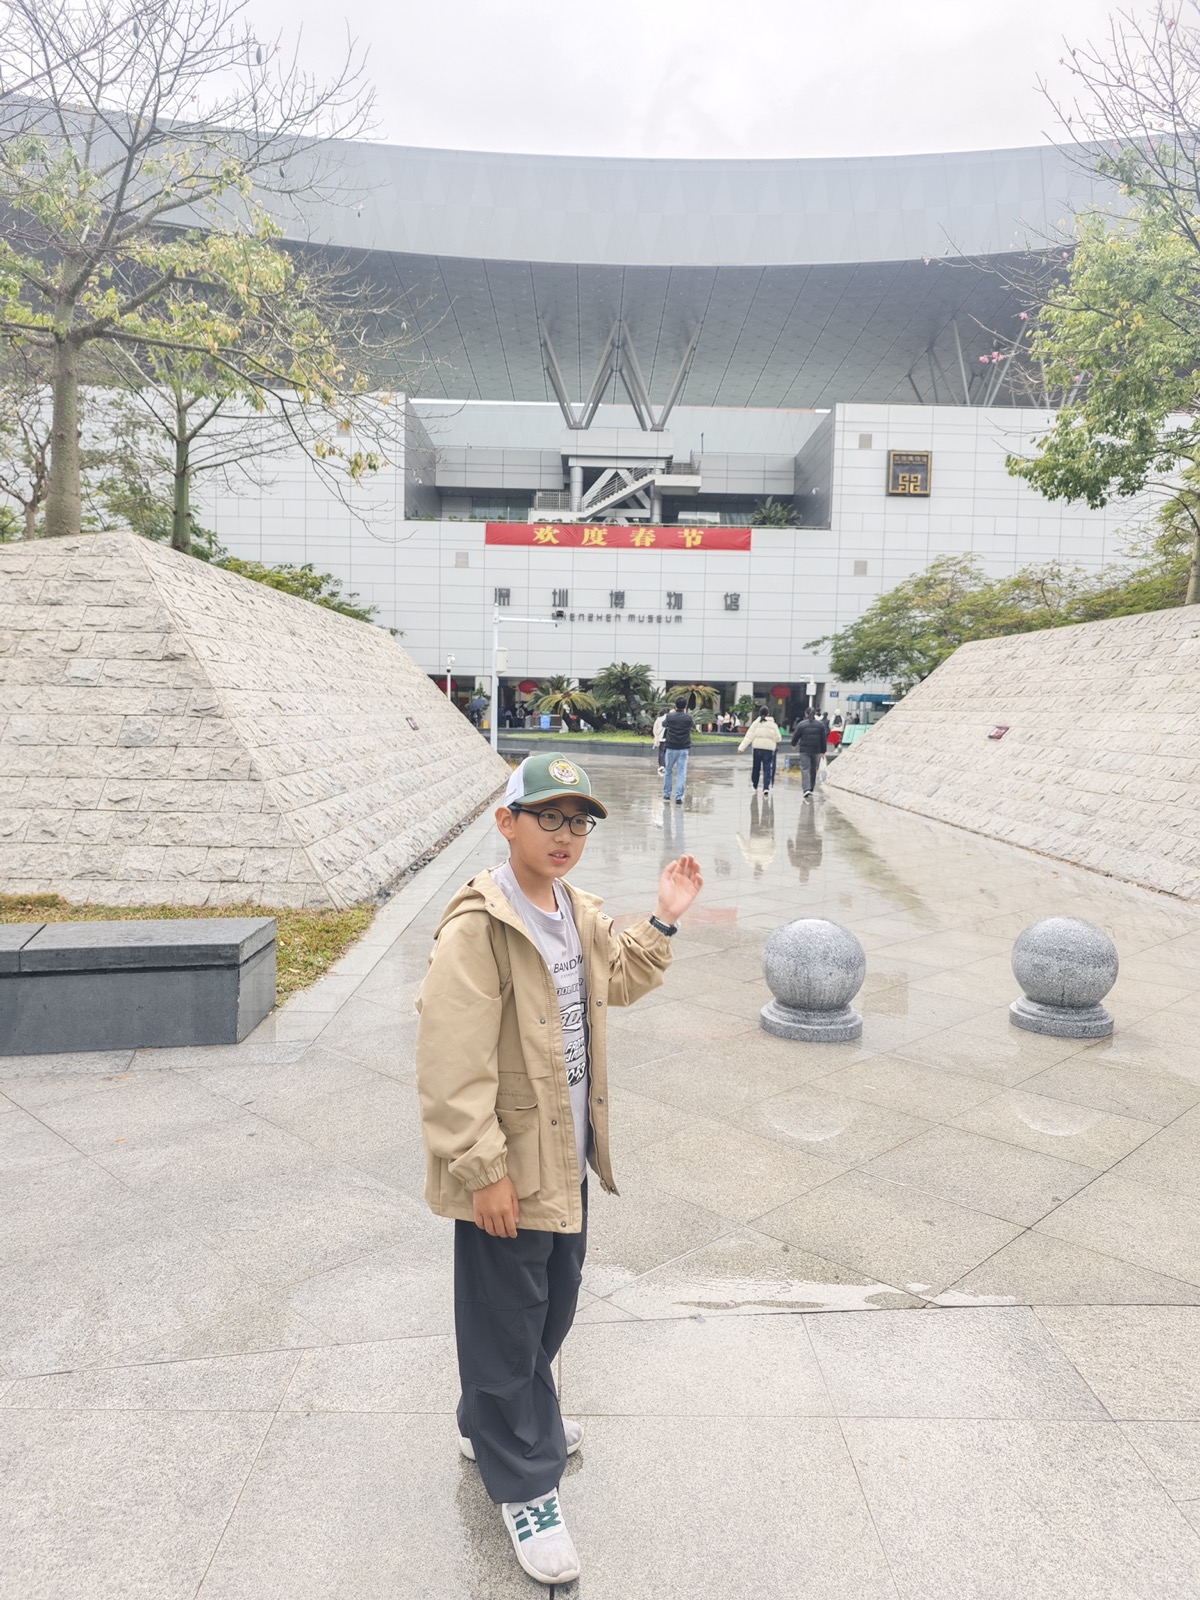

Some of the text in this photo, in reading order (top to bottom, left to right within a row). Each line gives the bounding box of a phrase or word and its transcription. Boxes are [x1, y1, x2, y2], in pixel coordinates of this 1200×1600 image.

[533, 526, 704, 548] 欢度春节
[494, 587, 740, 611] 深圳博物馆
[551, 612, 621, 623] SENZHEN
